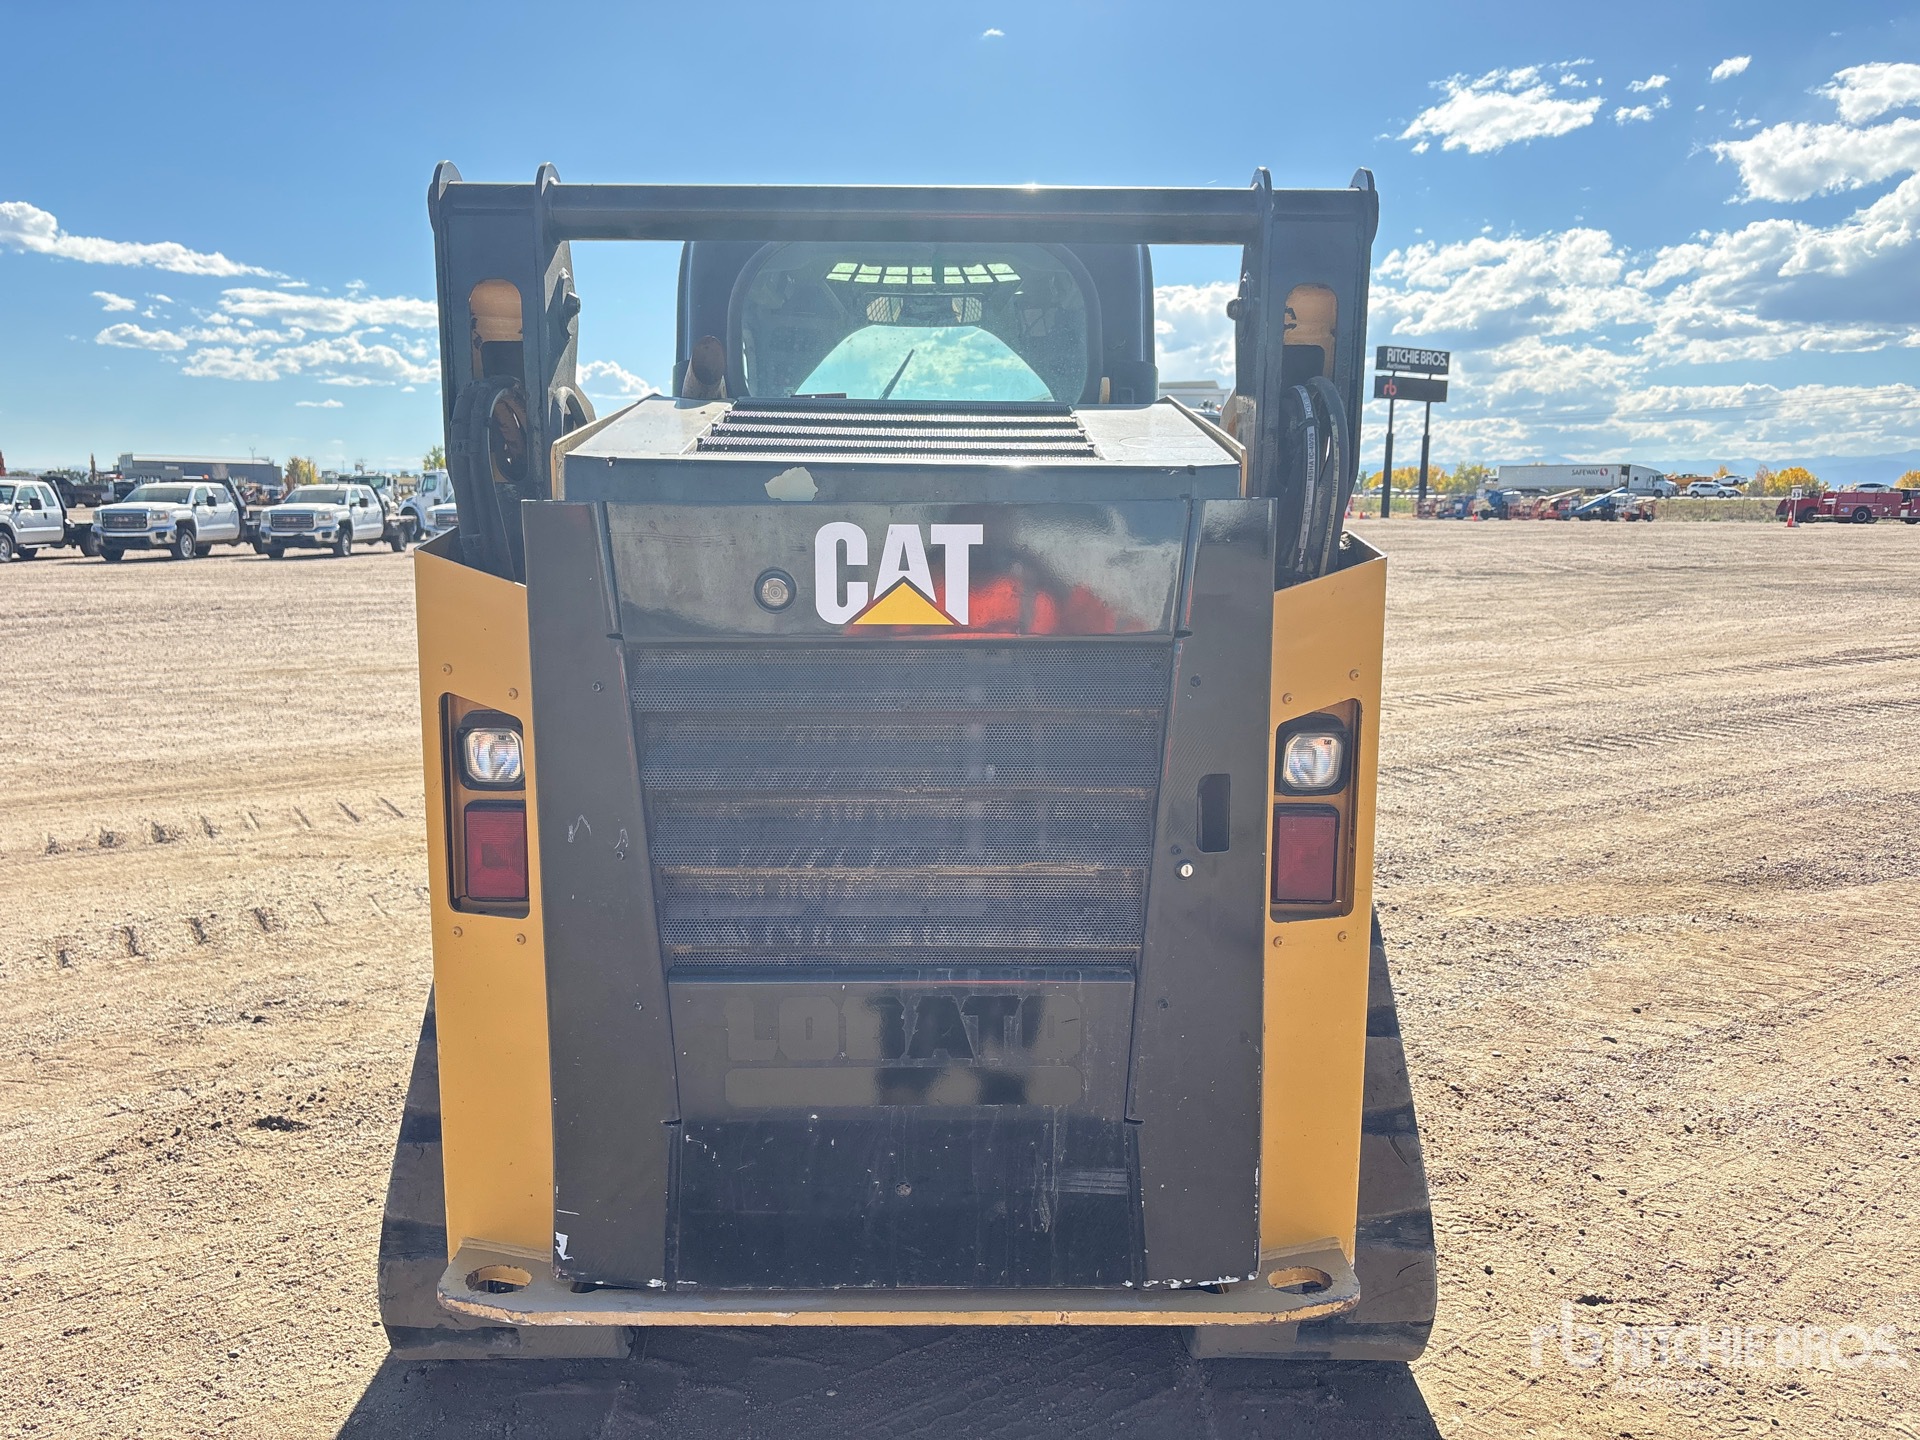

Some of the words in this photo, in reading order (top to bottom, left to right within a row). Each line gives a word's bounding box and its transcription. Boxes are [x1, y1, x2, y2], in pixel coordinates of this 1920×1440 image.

[1387, 348, 1420, 364] RITCHIE
[1420, 351, 1447, 366] BROS.
[815, 522, 983, 625] CAT
